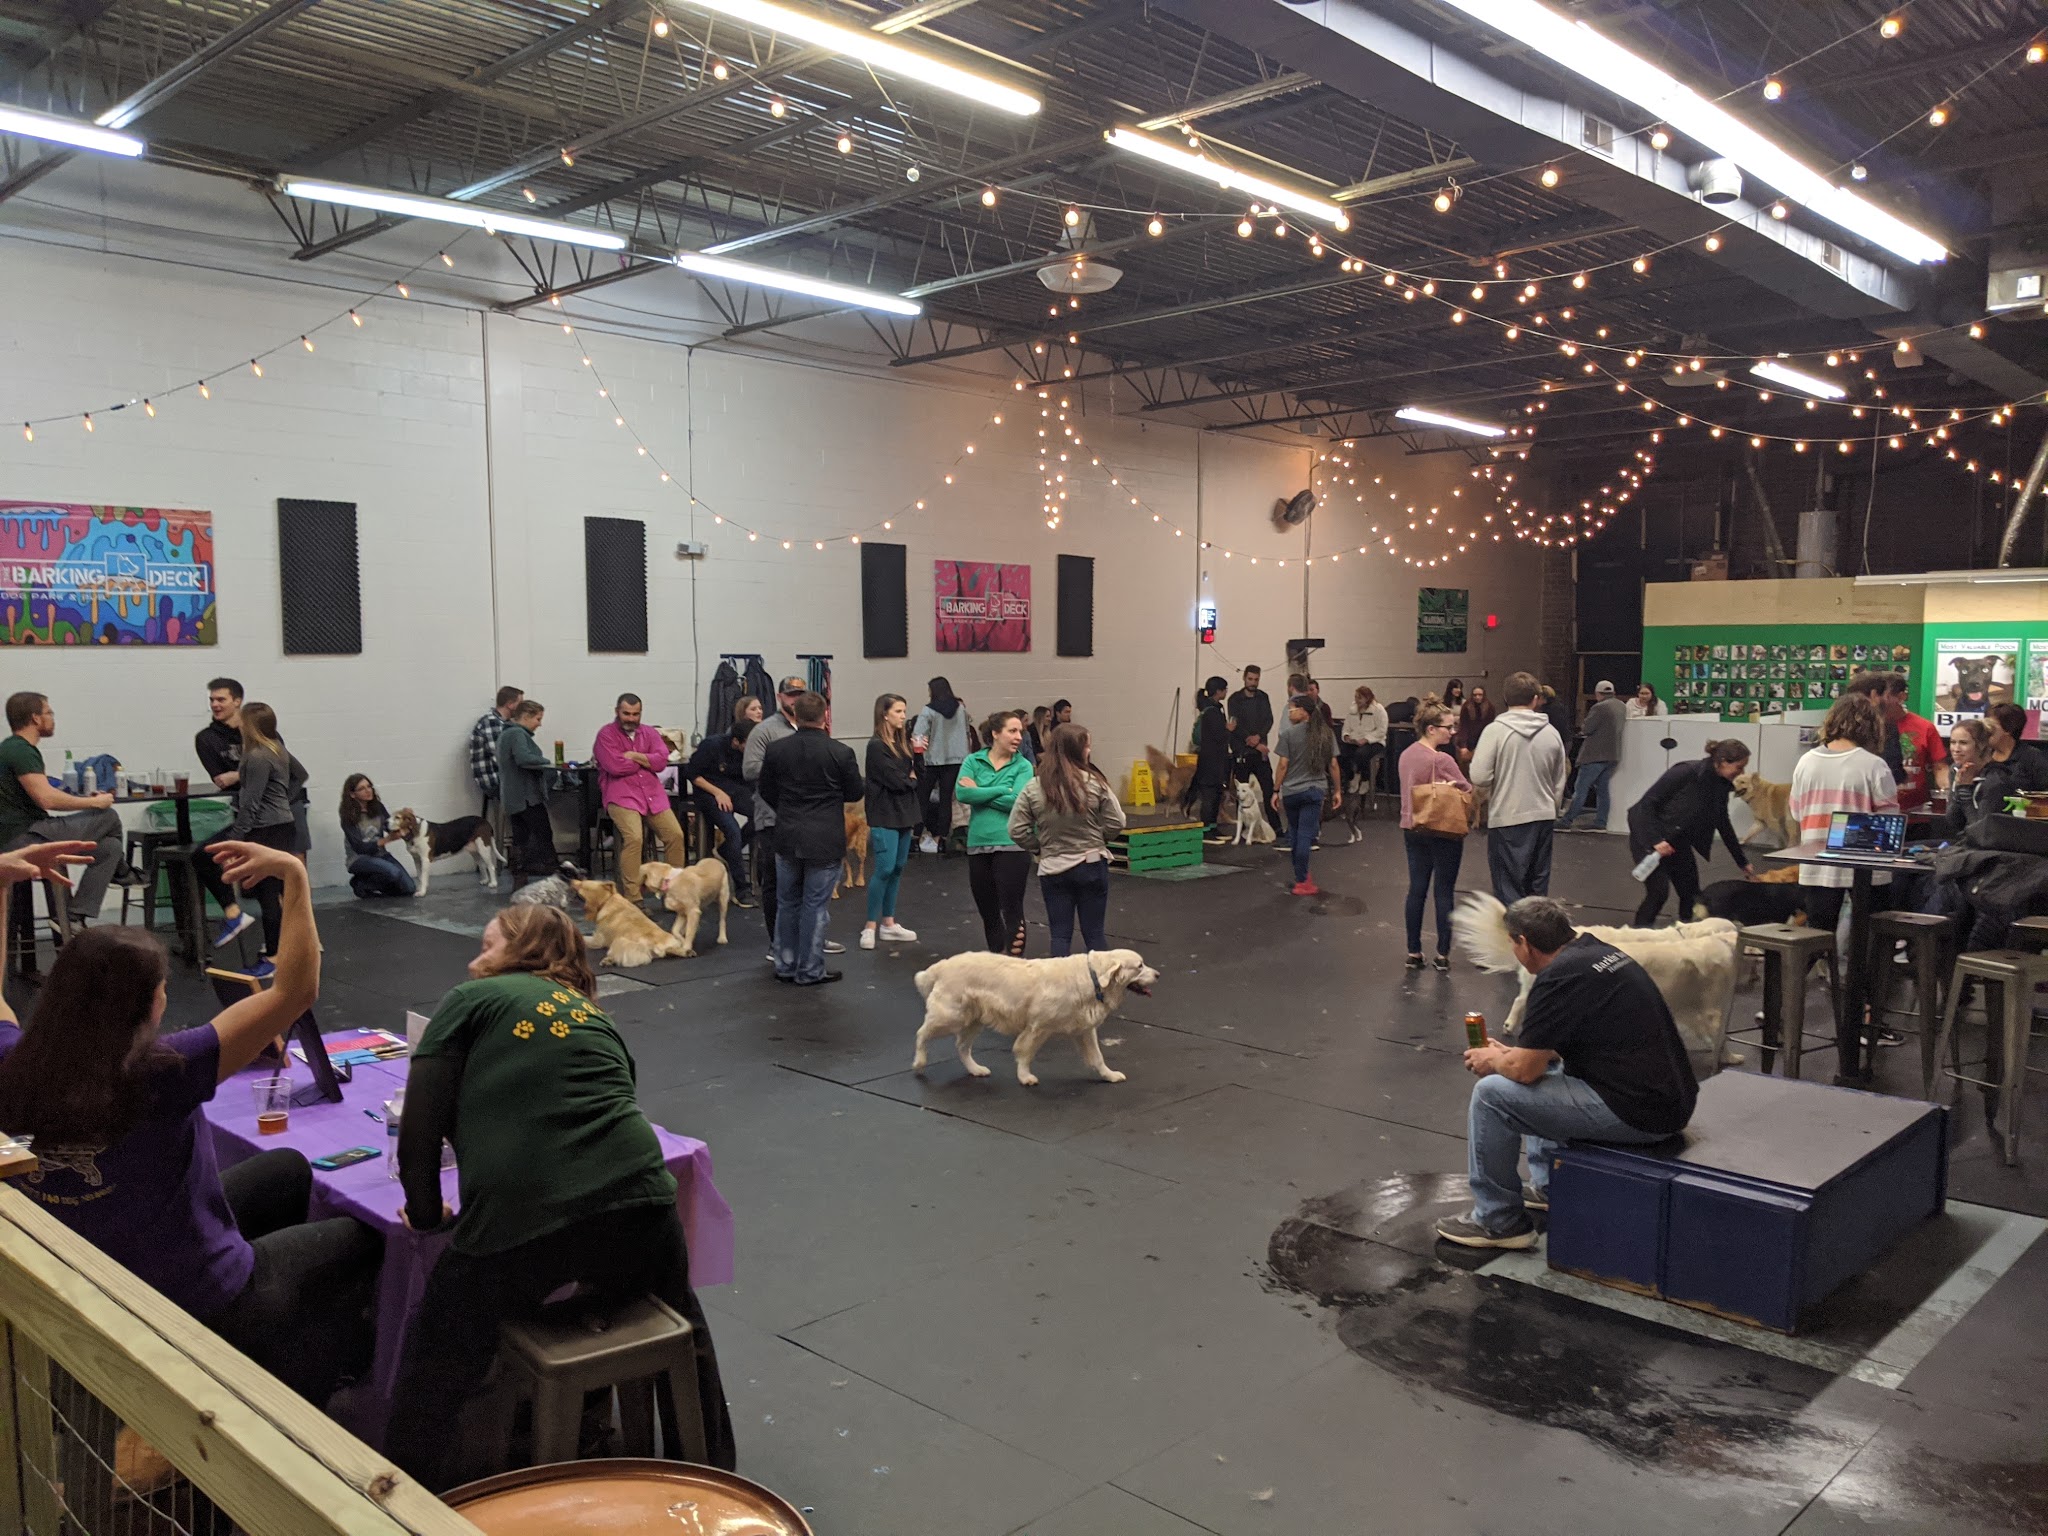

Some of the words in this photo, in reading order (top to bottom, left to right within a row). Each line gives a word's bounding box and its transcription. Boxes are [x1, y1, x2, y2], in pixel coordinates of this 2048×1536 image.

[12, 566, 105, 585] BARKING
[149, 570, 202, 588] DECK
[946, 602, 986, 613] BARKING
[1004, 604, 1027, 614] DECK
